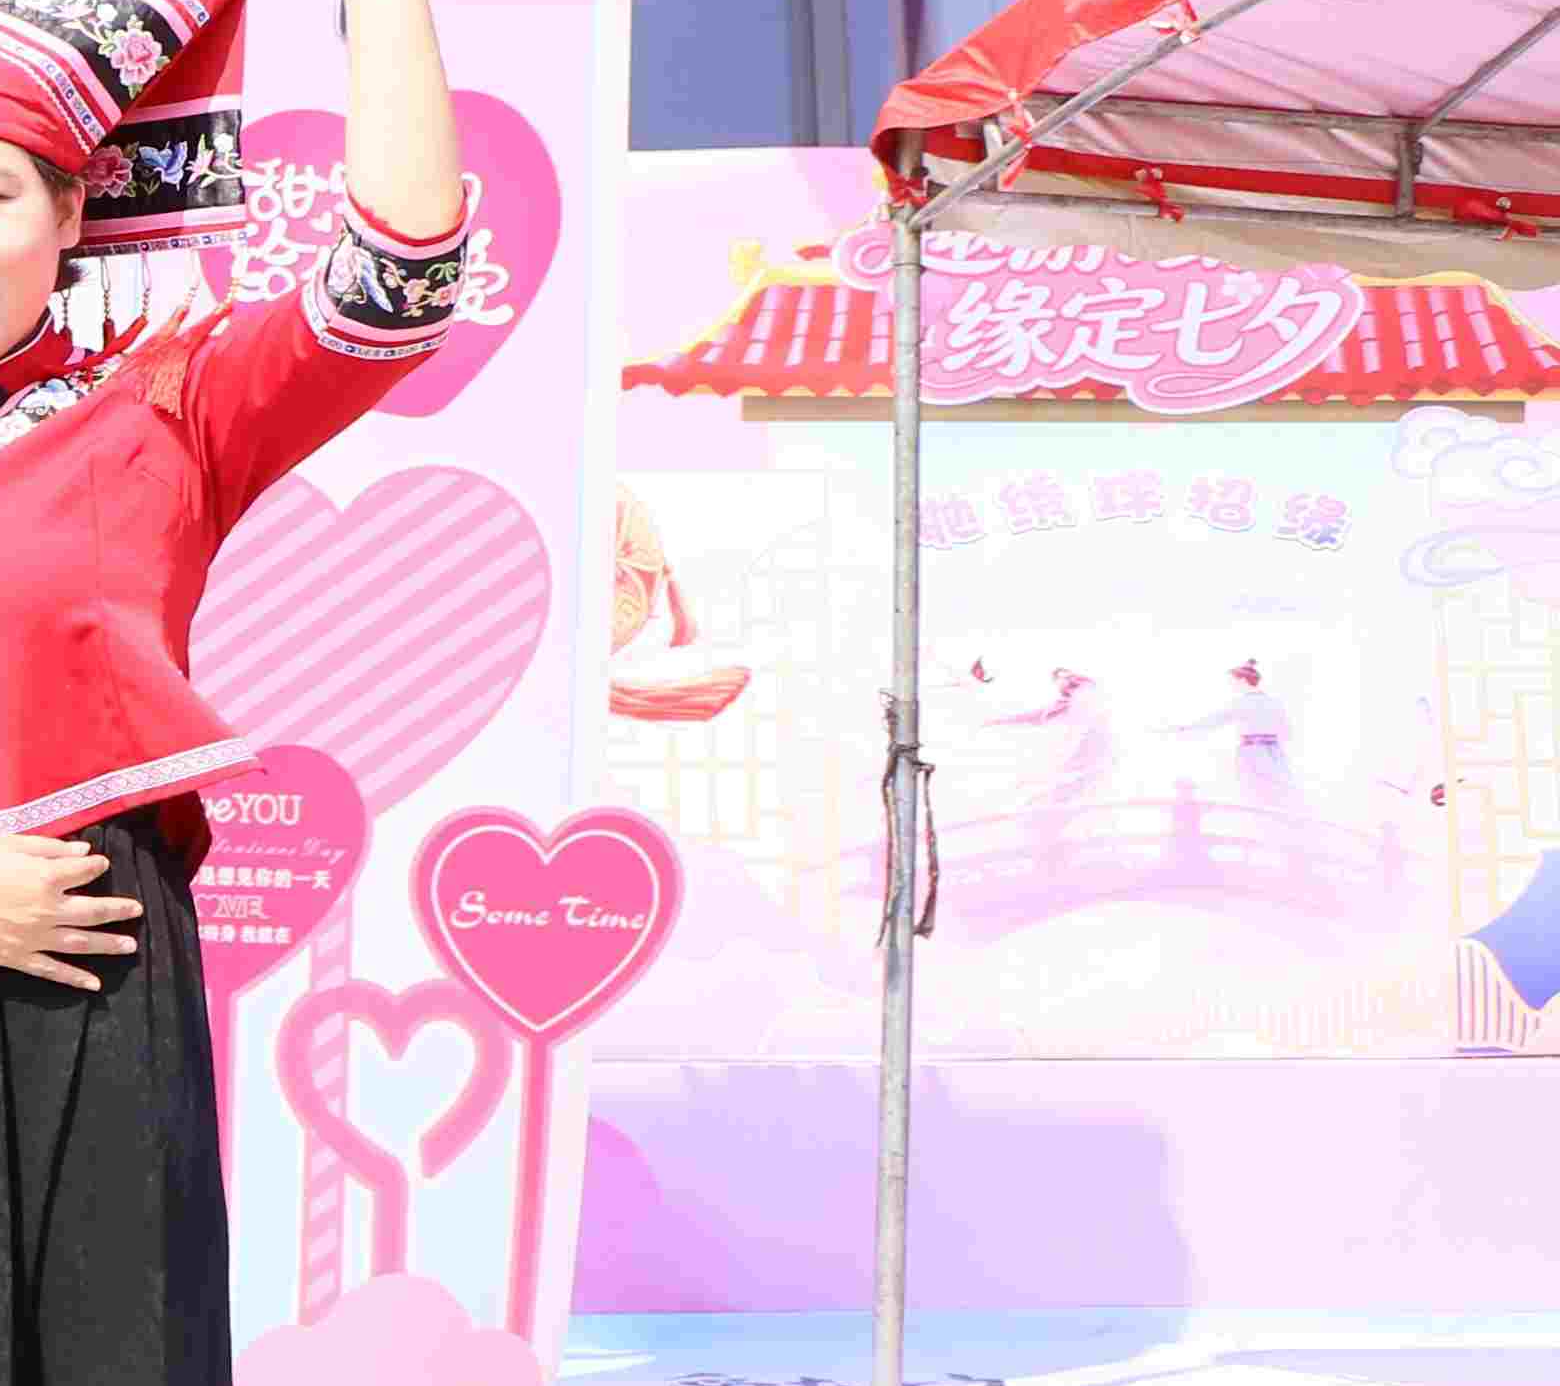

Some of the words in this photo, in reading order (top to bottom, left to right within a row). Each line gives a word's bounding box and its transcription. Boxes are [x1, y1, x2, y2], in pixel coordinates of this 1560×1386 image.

[940, 276, 1342, 398] 缘定七夕
[450, 890, 551, 929] Some
[557, 895, 646, 930] Time
